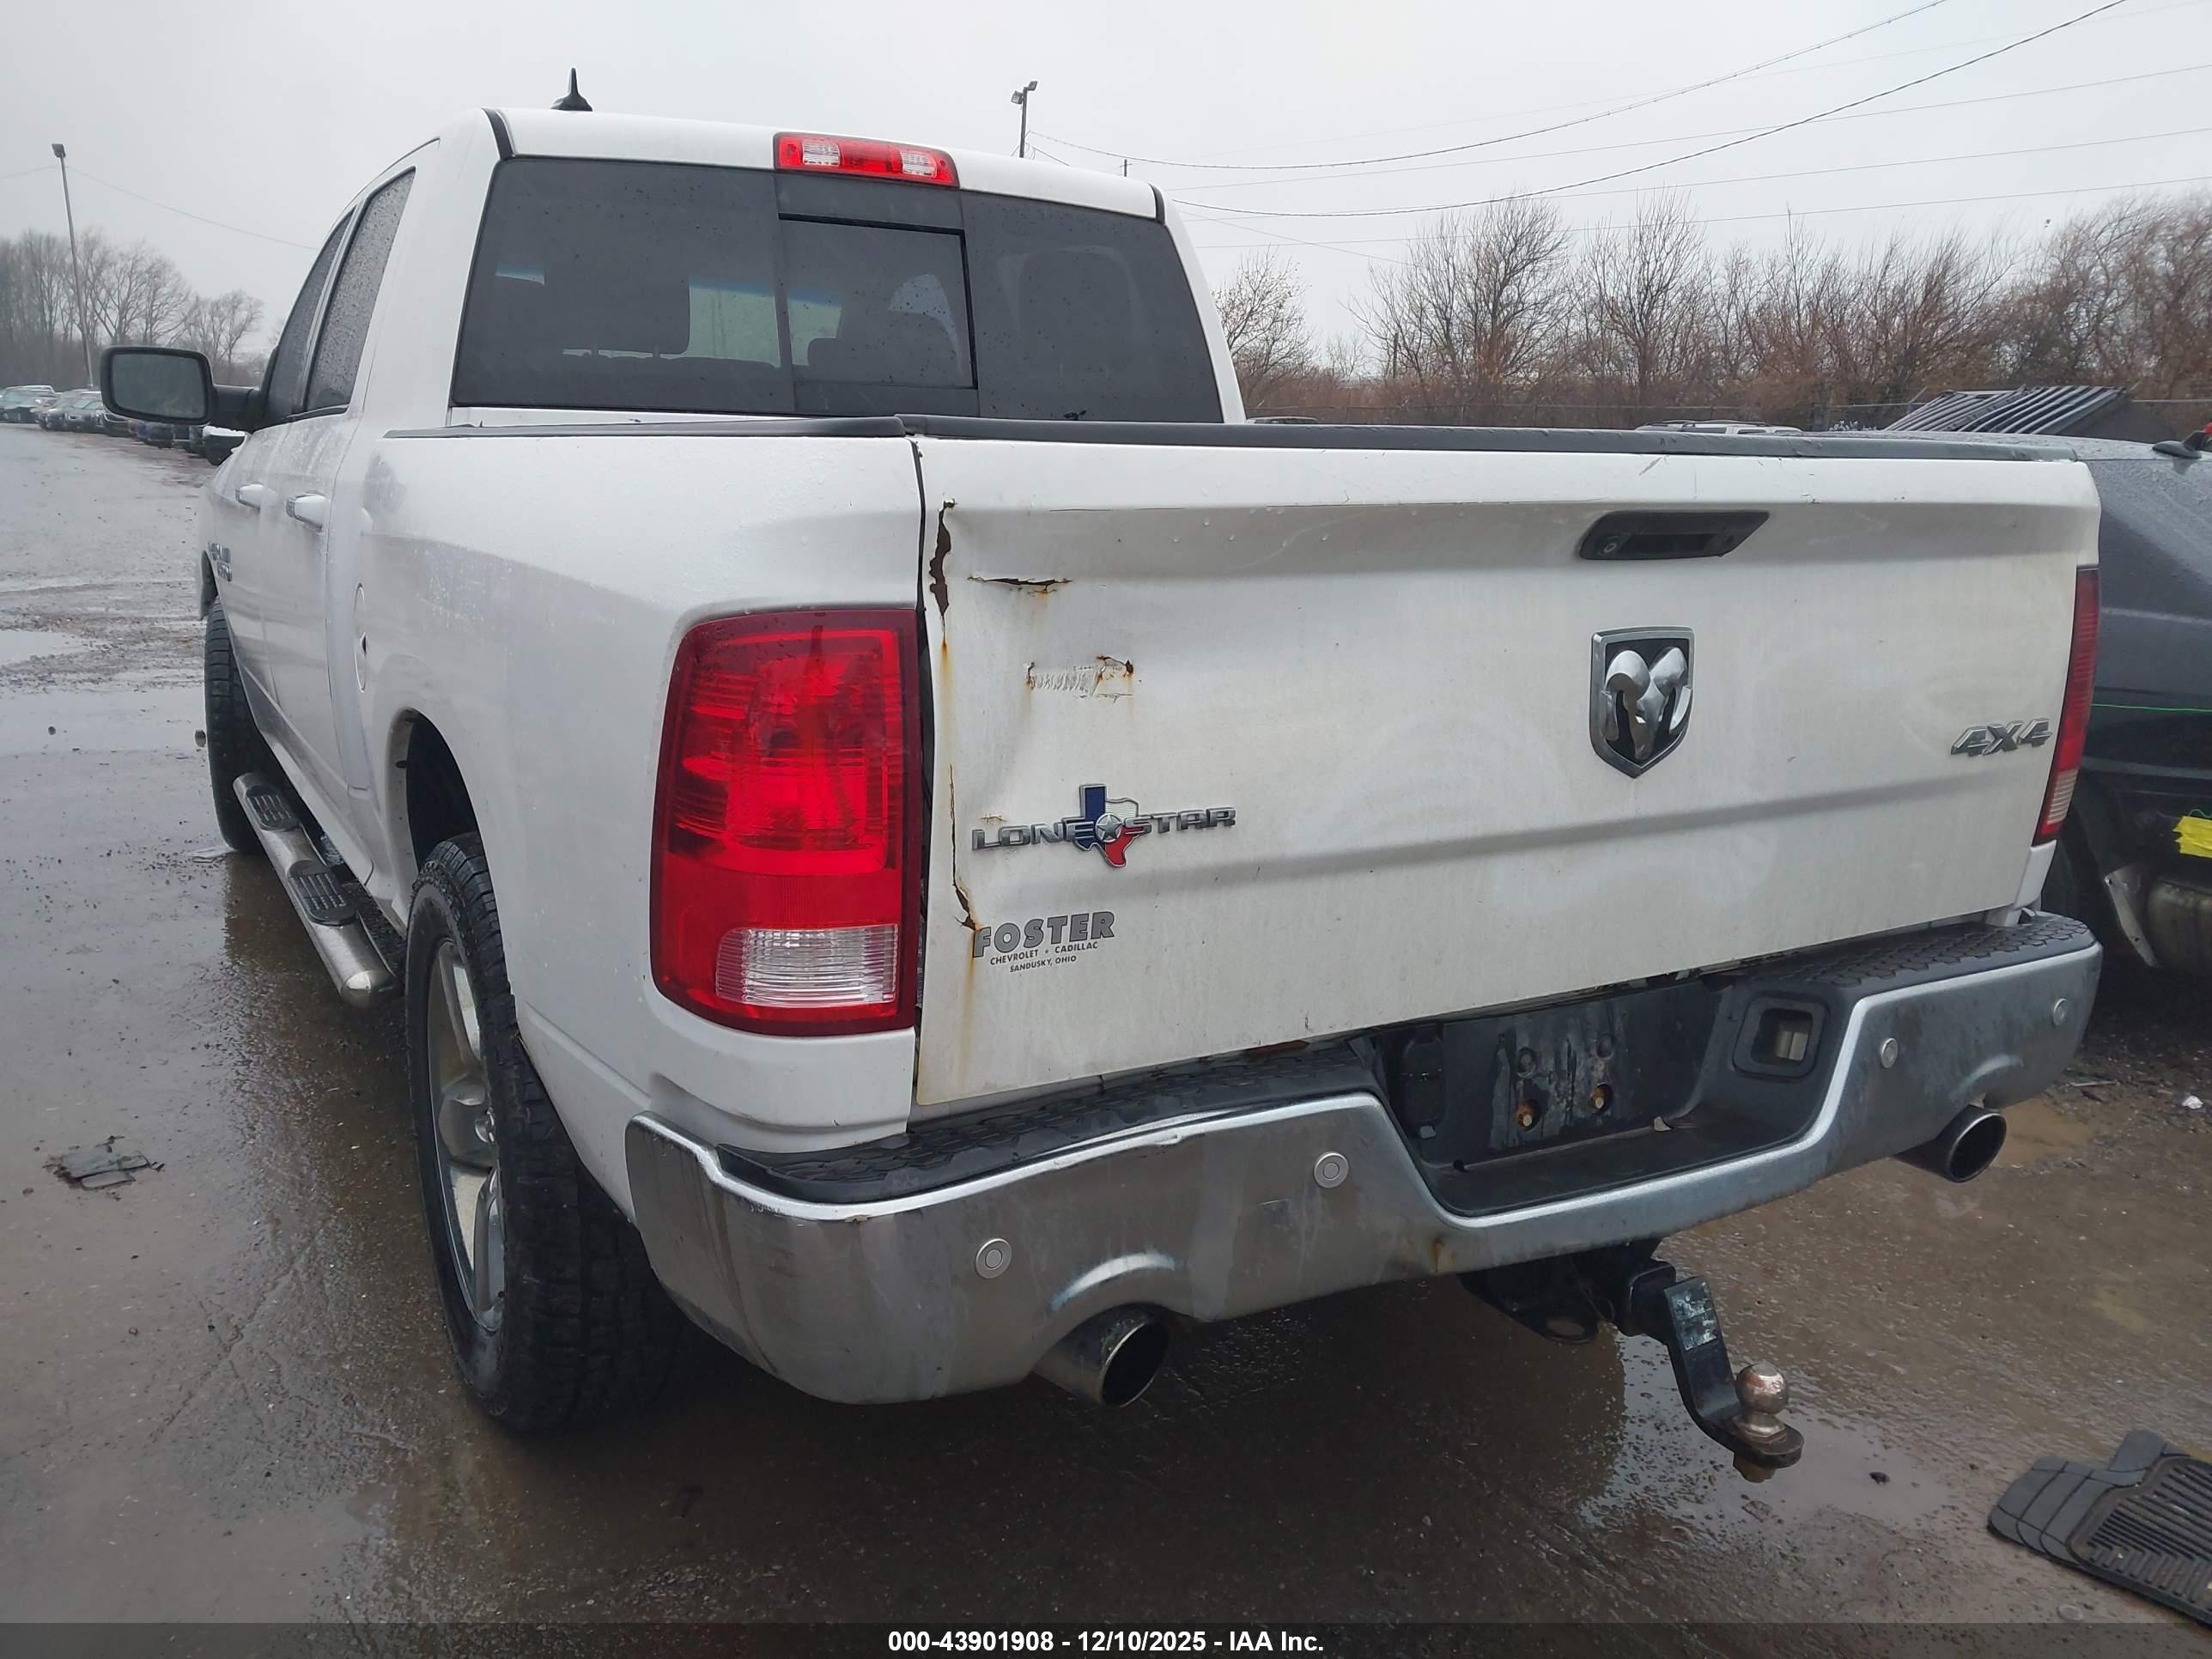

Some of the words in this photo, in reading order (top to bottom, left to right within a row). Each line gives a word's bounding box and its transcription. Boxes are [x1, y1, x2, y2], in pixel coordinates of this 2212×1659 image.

[1950, 718, 2052, 757] 4X4
[972, 816, 1097, 852] LONE
[1122, 806, 1237, 836] STAR
[972, 911, 1115, 958] FOSTER
[989, 949, 1039, 965] CHEVROLET
[1054, 941, 1098, 954] CADILLAC
[1009, 958, 1053, 973] SANDUSKY,
[1054, 955, 1077, 964] OHIO
